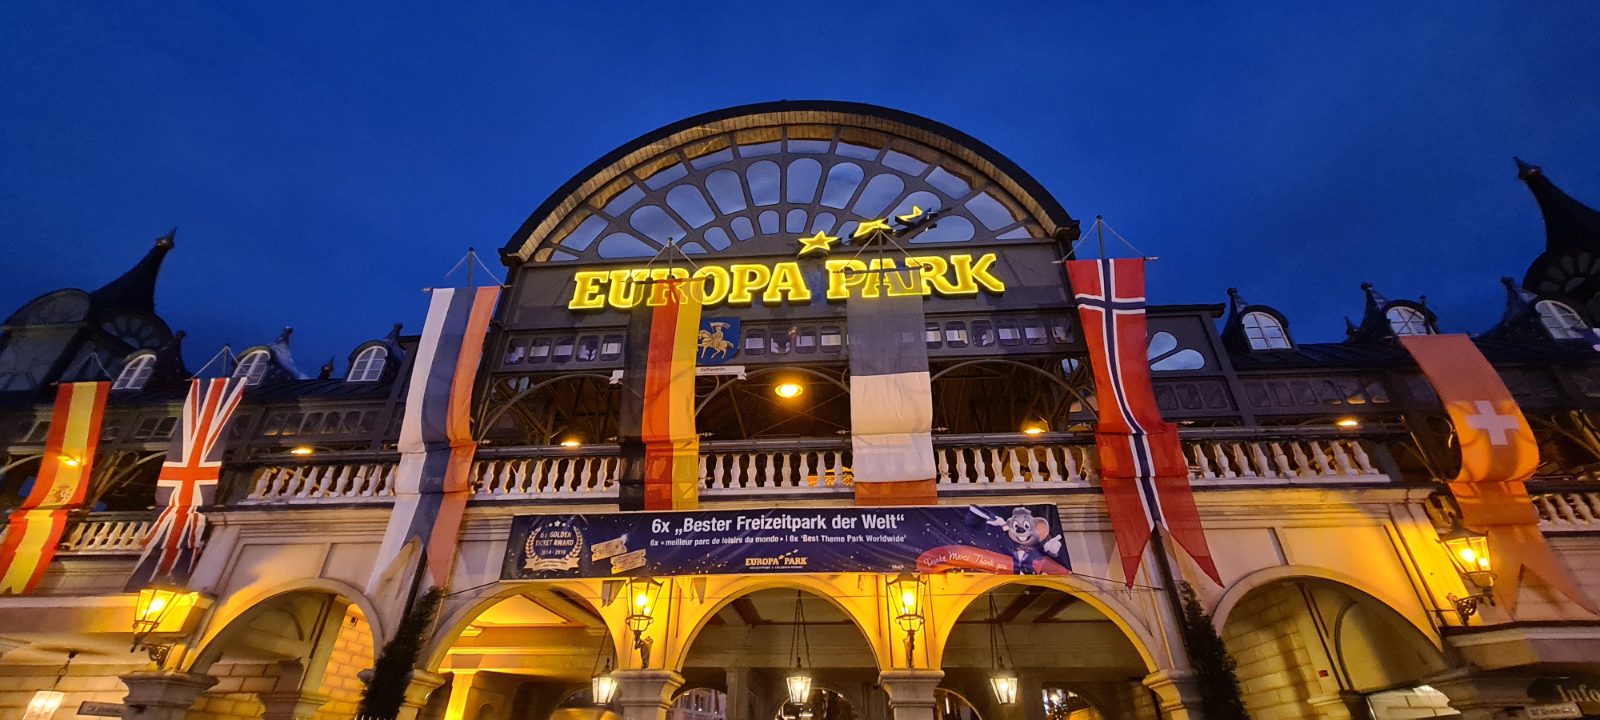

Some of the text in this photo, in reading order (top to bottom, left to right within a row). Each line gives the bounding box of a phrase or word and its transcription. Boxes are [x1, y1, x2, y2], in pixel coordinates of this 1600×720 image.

[568, 253, 1006, 310] EUROPA PARK
[651, 518, 670, 533] 6x
[675, 516, 732, 535] „Bester
[737, 514, 827, 532] Freizeitpark
[831, 514, 857, 529] der
[694, 538, 710, 546] parc
[711, 537, 720, 545] de
[722, 536, 743, 544] loisirs
[821, 535, 845, 543] Theme
[745, 557, 808, 566] EUROPA PARK
[948, 551, 970, 561] Merci
[973, 553, 995, 567] Thank
[996, 562, 1008, 571] you
